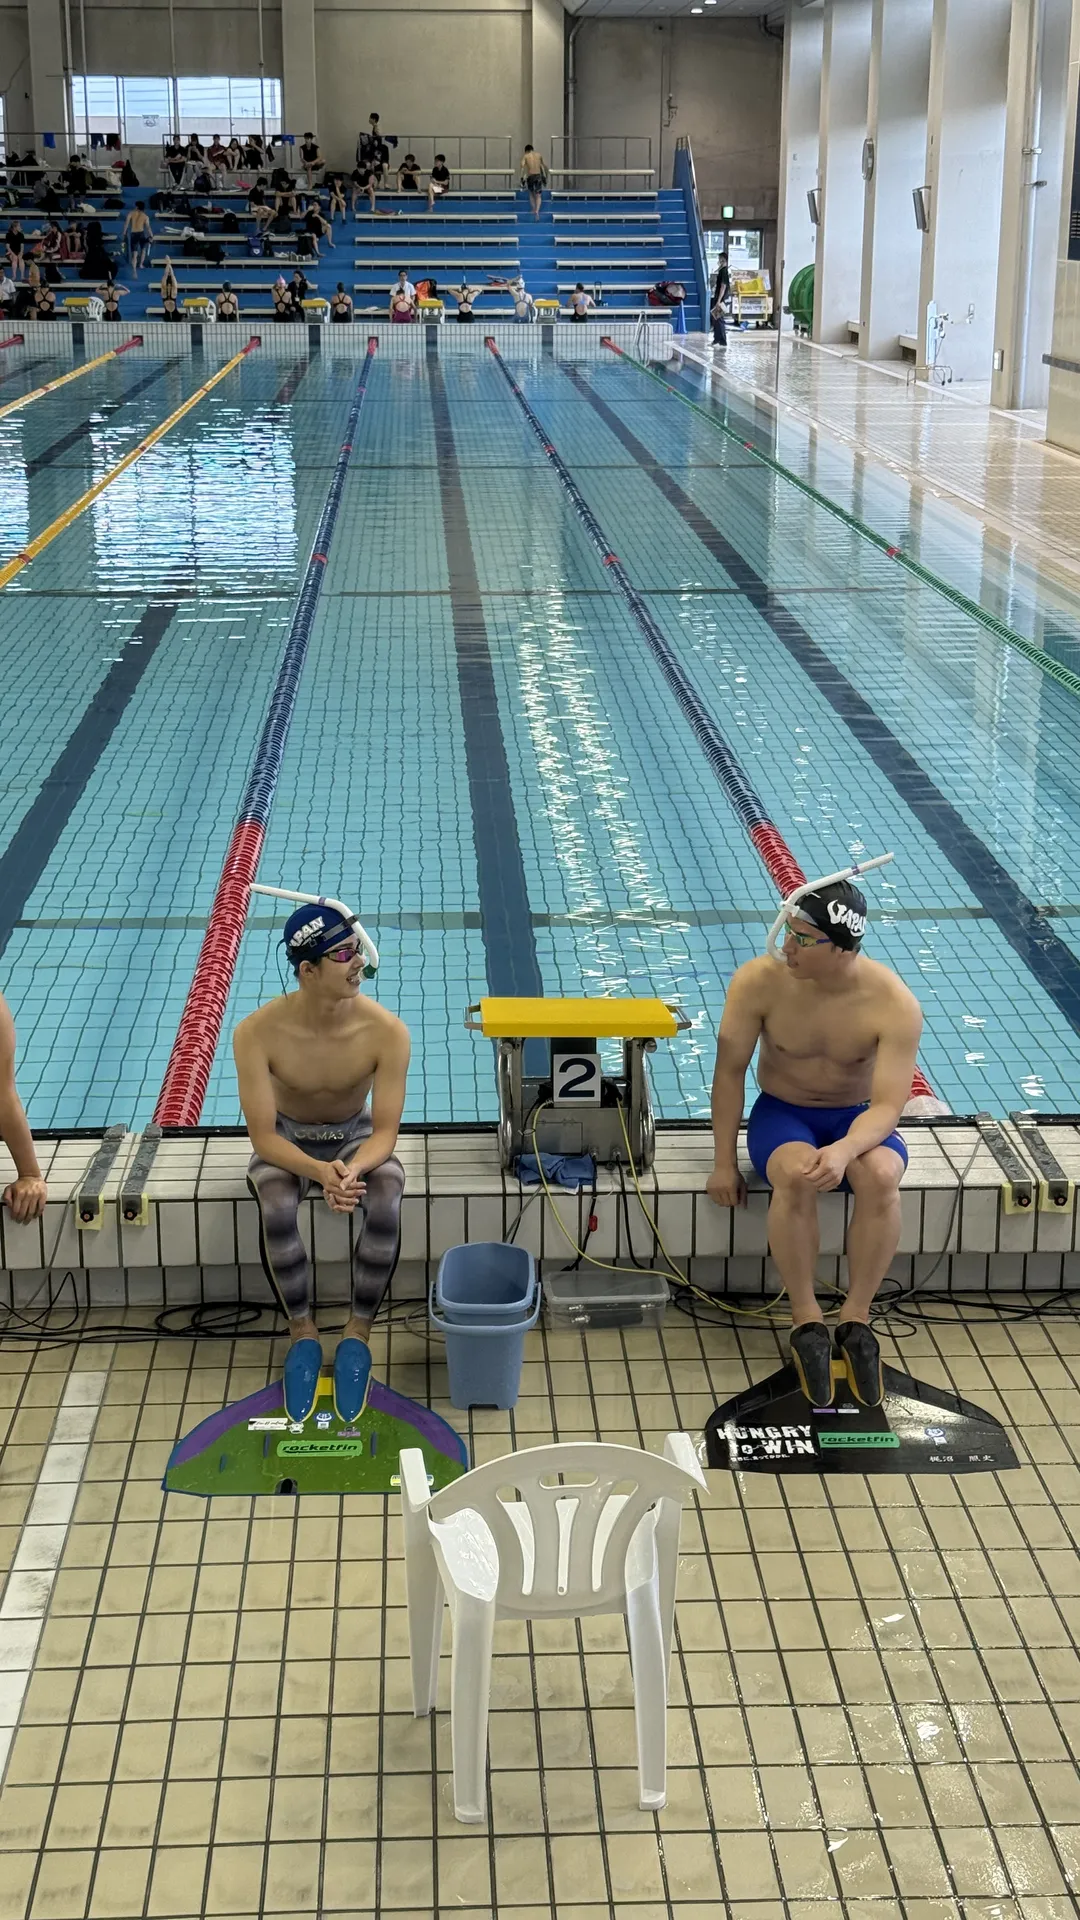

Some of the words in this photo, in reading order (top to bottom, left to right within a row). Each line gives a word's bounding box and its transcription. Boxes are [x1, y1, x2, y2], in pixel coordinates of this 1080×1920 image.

[558, 1057, 596, 1098] 2
[716, 1425, 811, 1440] HUNGRY
[761, 1440, 816, 1454] WIN
[821, 1436, 895, 1444] rocketfin
[282, 1443, 358, 1453] rocketfin
